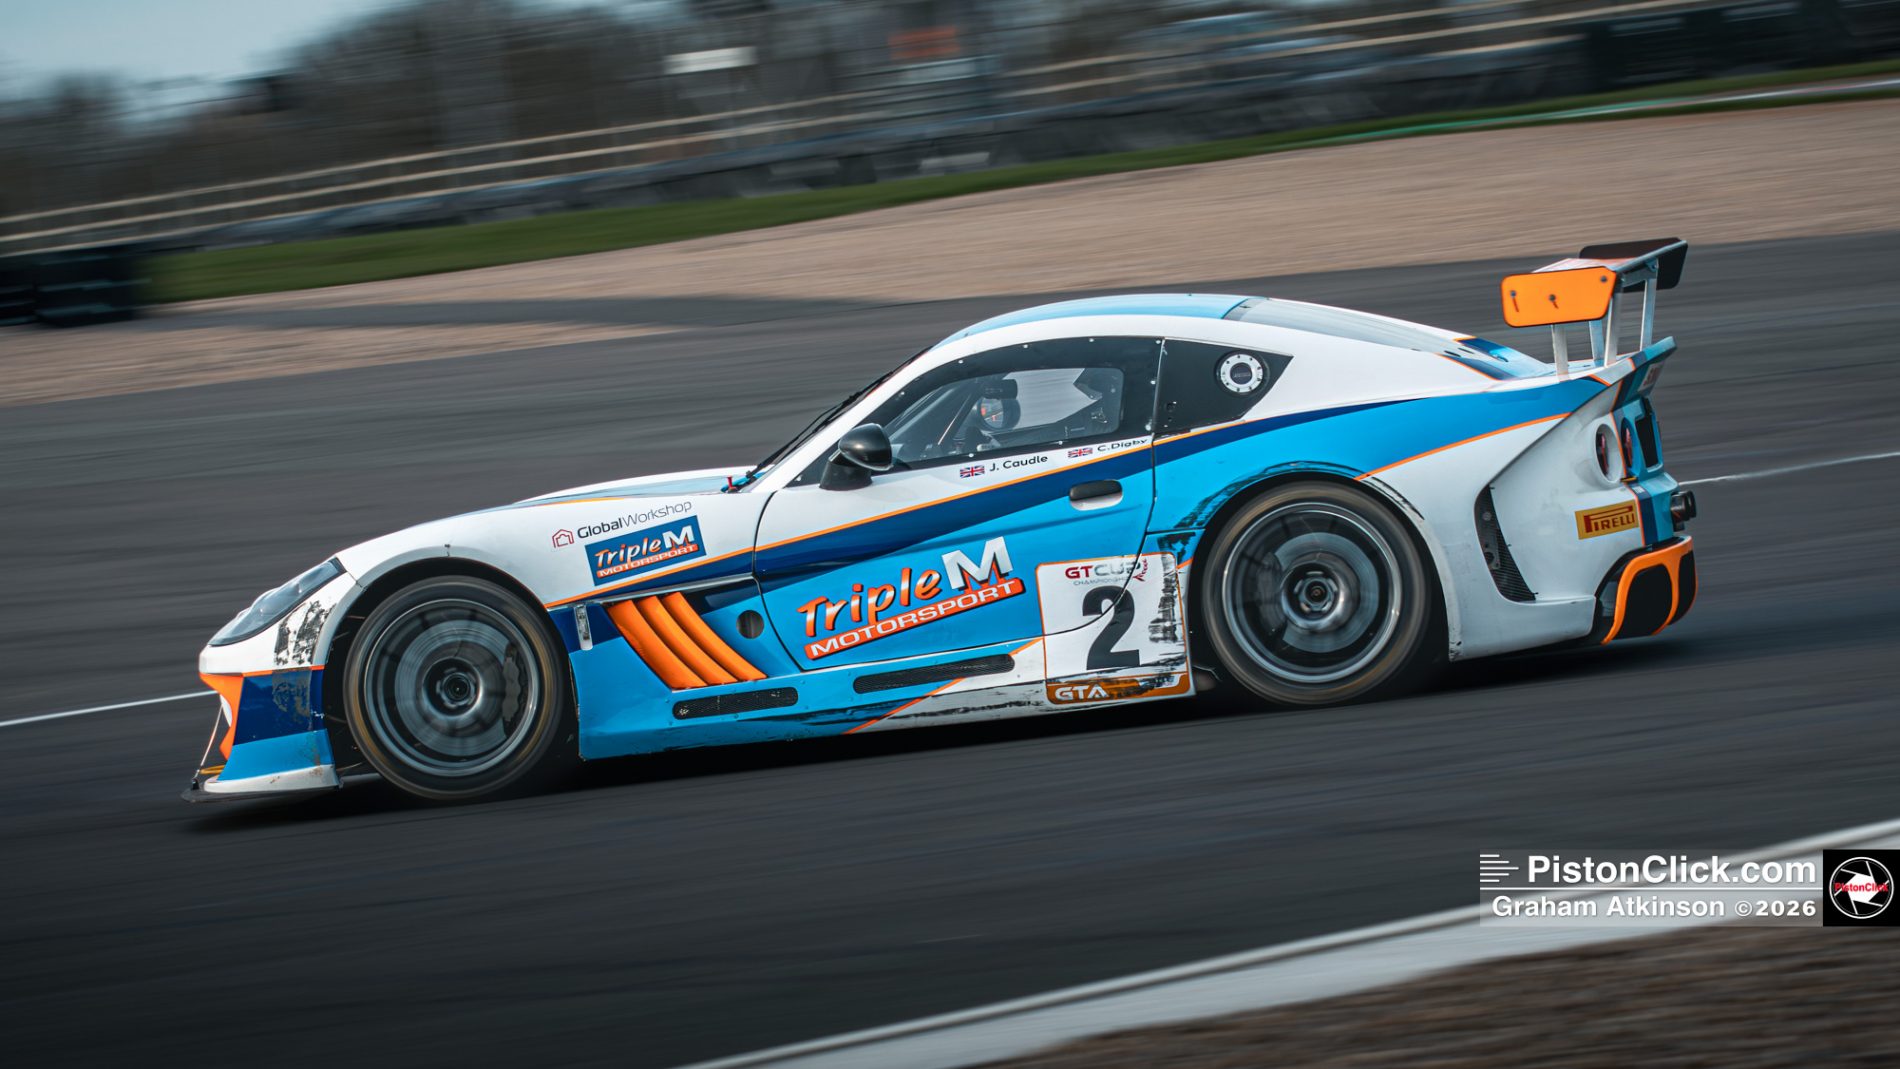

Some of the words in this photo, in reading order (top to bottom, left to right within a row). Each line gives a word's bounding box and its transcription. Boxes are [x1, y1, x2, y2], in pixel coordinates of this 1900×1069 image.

[989, 462, 1000, 472] J.
[1002, 455, 1049, 469] Caudle
[1583, 505, 1636, 533] PIRELLI
[599, 544, 697, 577] MOTORSPORT
[810, 580, 1016, 657] MOTORSPORT
[1082, 585, 1140, 670] 2
[1055, 684, 1109, 701] GTA
